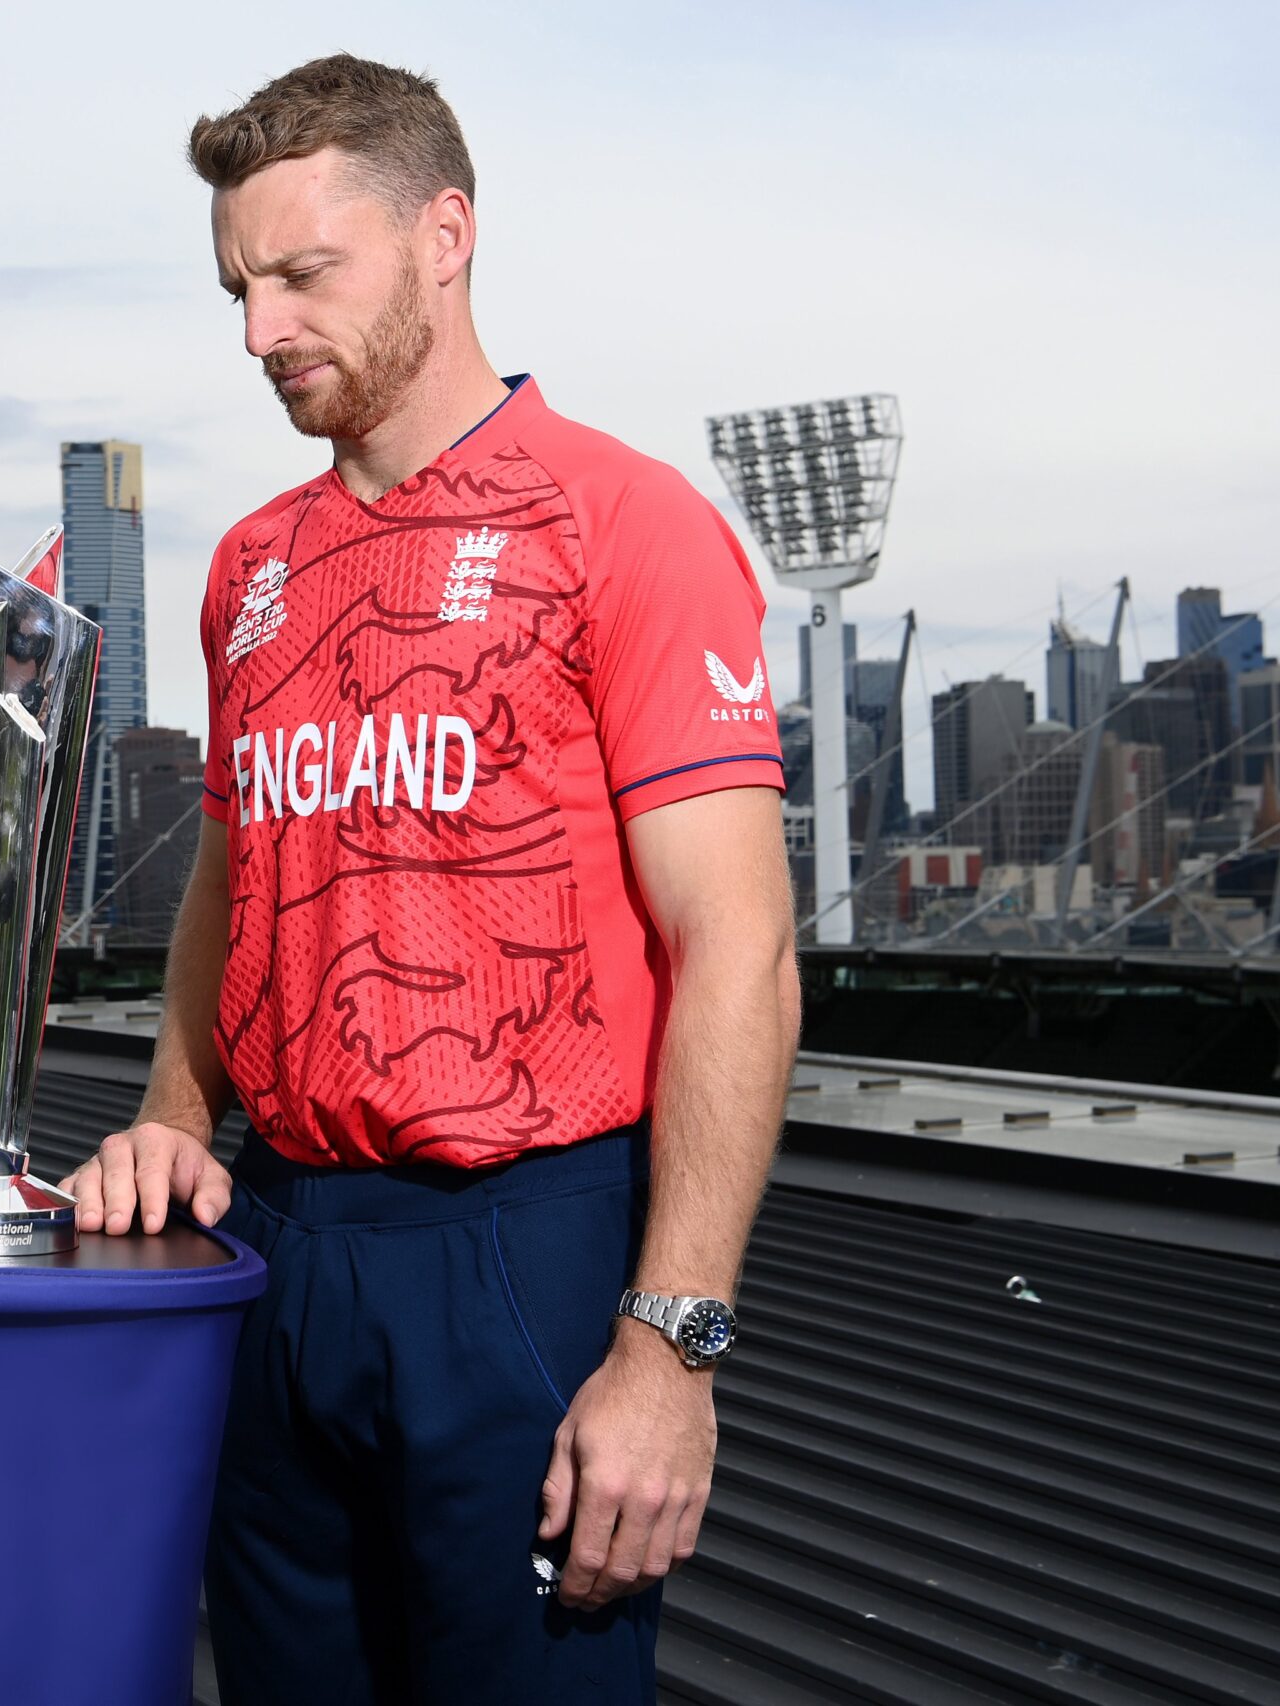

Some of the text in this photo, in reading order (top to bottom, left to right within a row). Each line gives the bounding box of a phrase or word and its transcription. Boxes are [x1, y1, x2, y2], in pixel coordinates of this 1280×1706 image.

[226, 612, 288, 657] WORLD CUP
[231, 601, 284, 640] MEN'S T20
[811, 604, 826, 628] 6
[227, 639, 261, 666] AUSTRALIA
[233, 713, 476, 828] ENGLAND
